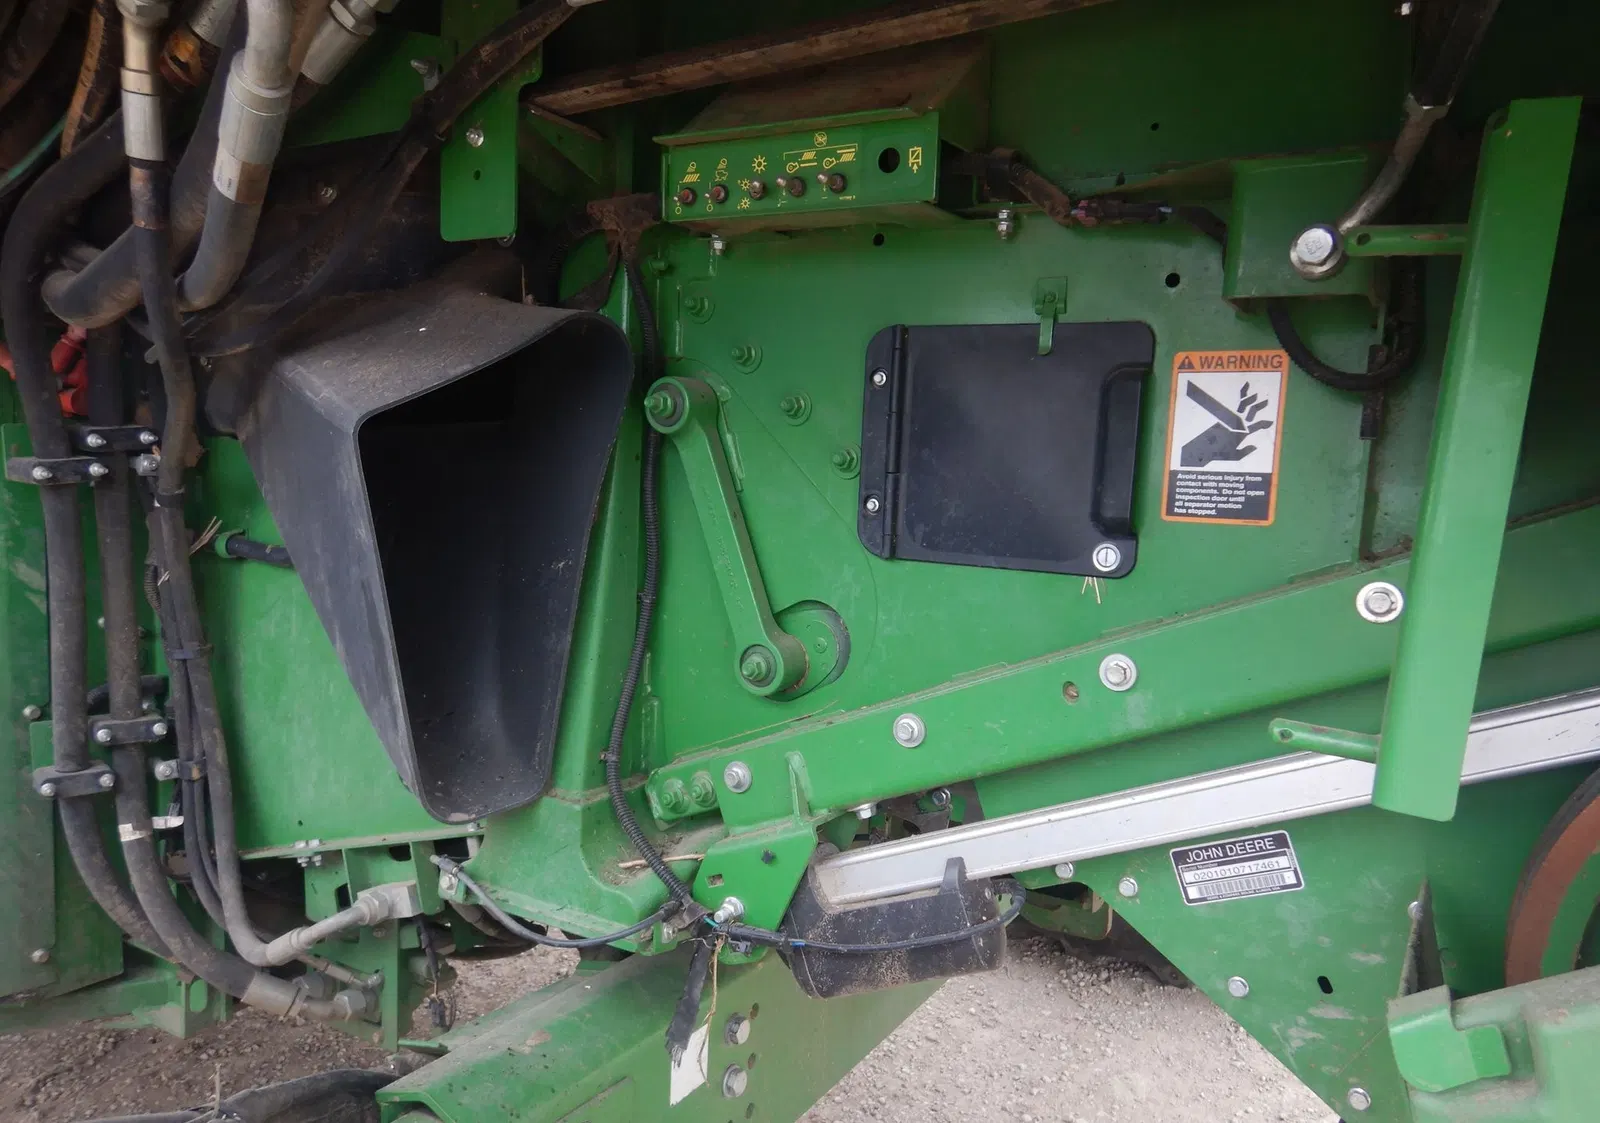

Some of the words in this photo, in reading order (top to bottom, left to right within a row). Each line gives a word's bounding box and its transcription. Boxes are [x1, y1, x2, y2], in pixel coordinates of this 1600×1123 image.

[1199, 354, 1283, 369] WARNING
[1224, 475, 1244, 483] injury
[1175, 487, 1220, 495] components.
[1175, 493, 1210, 502] inspection
[1184, 501, 1216, 509] separator
[1187, 508, 1217, 516] stopped.
[1186, 847, 1224, 863] JOHN
[1226, 838, 1276, 856] DEERE
[1193, 860, 1281, 881] 0201010717461
